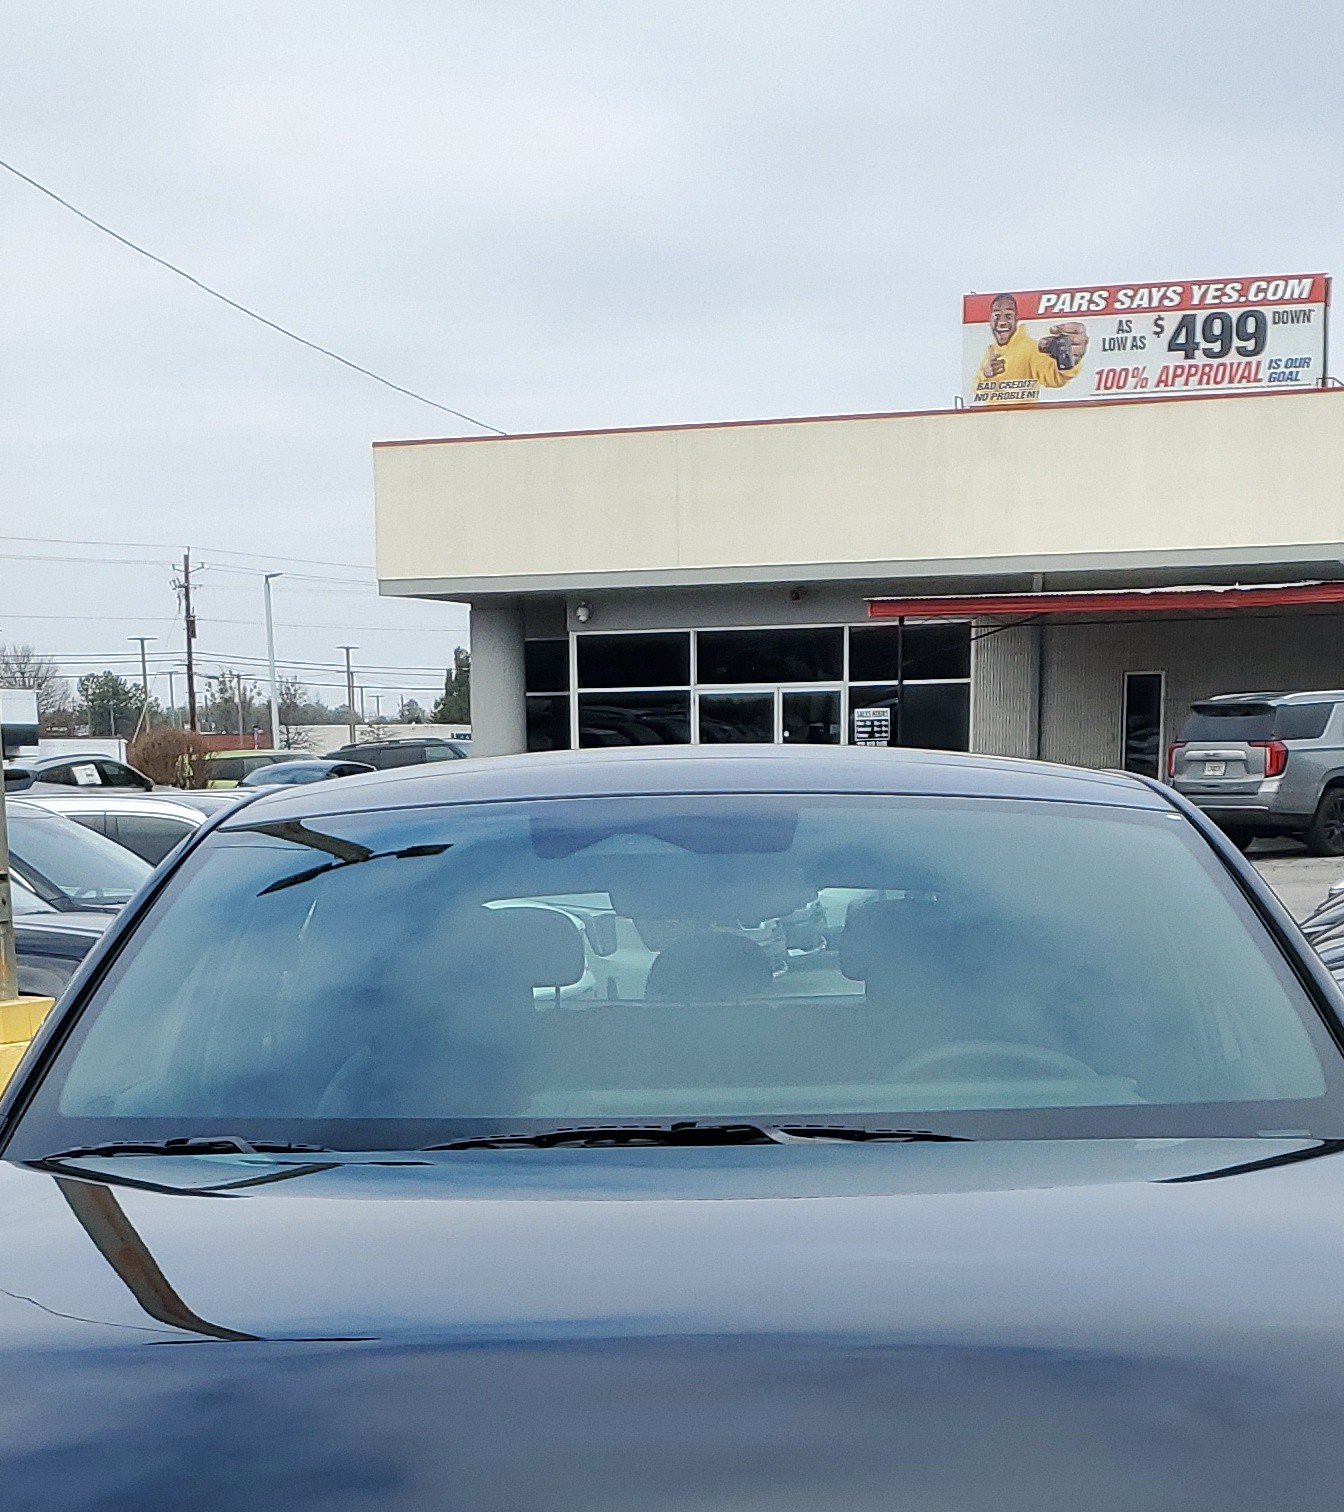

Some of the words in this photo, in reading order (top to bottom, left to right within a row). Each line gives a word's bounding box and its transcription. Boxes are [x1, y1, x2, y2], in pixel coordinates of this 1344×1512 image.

[1037, 290, 1109, 315] PARS
[1113, 286, 1184, 309] SAYS
[1190, 278, 1314, 305] YES.COM
[1117, 319, 1133, 334] AS
[1102, 336, 1128, 352] LOW
[1130, 335, 1146, 351] AS
[1268, 358, 1282, 370] IS
[1284, 357, 1312, 369] OUR
[1095, 366, 1149, 390] 100%
[1155, 361, 1263, 388] APPROVAL
[1268, 371, 1301, 382] GOAL
[977, 381, 996, 390] BAD
[974, 392, 989, 402] NO
